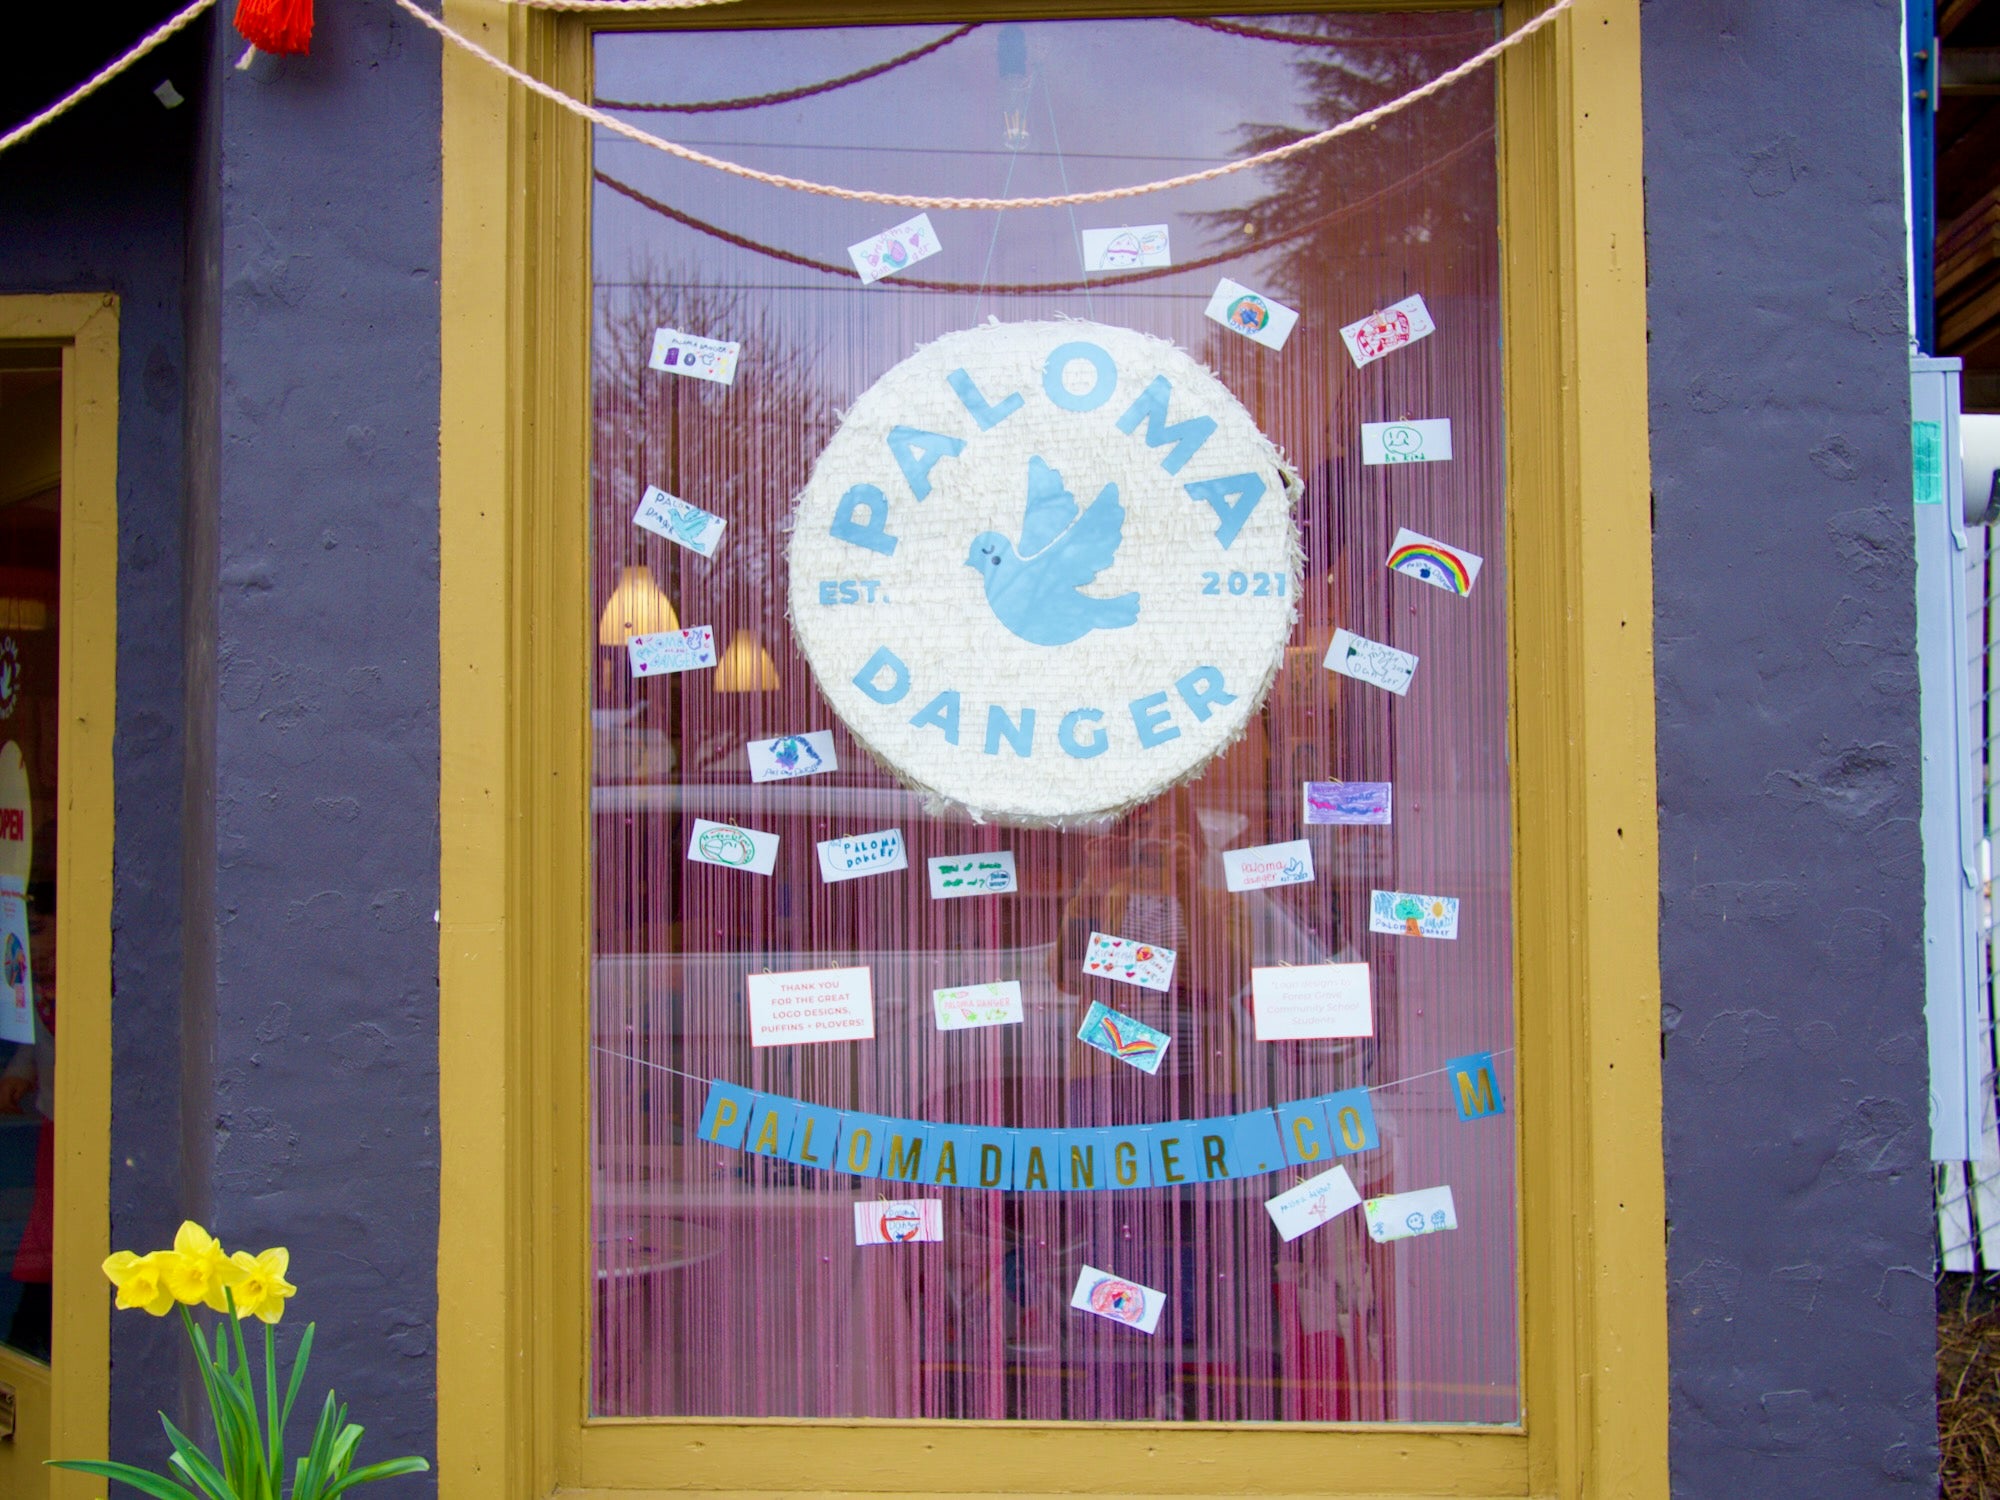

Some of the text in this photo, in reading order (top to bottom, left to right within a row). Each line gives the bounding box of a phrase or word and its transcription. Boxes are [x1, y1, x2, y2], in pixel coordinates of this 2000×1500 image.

[830, 341, 1267, 556] PALOMA
[819, 580, 890, 605] EST.
[1202, 571, 1286, 597] 2021
[852, 645, 1238, 759] DANGER
[844, 837, 897, 854] PALOMA
[780, 981, 840, 992] THANK YOU
[771, 993, 850, 1006] FOR THE GREAT
[772, 1006, 852, 1019] LOGO DESIGNS,
[760, 1023, 805, 1033] PUFFINS
[815, 1018, 865, 1029] PLOVERS!
